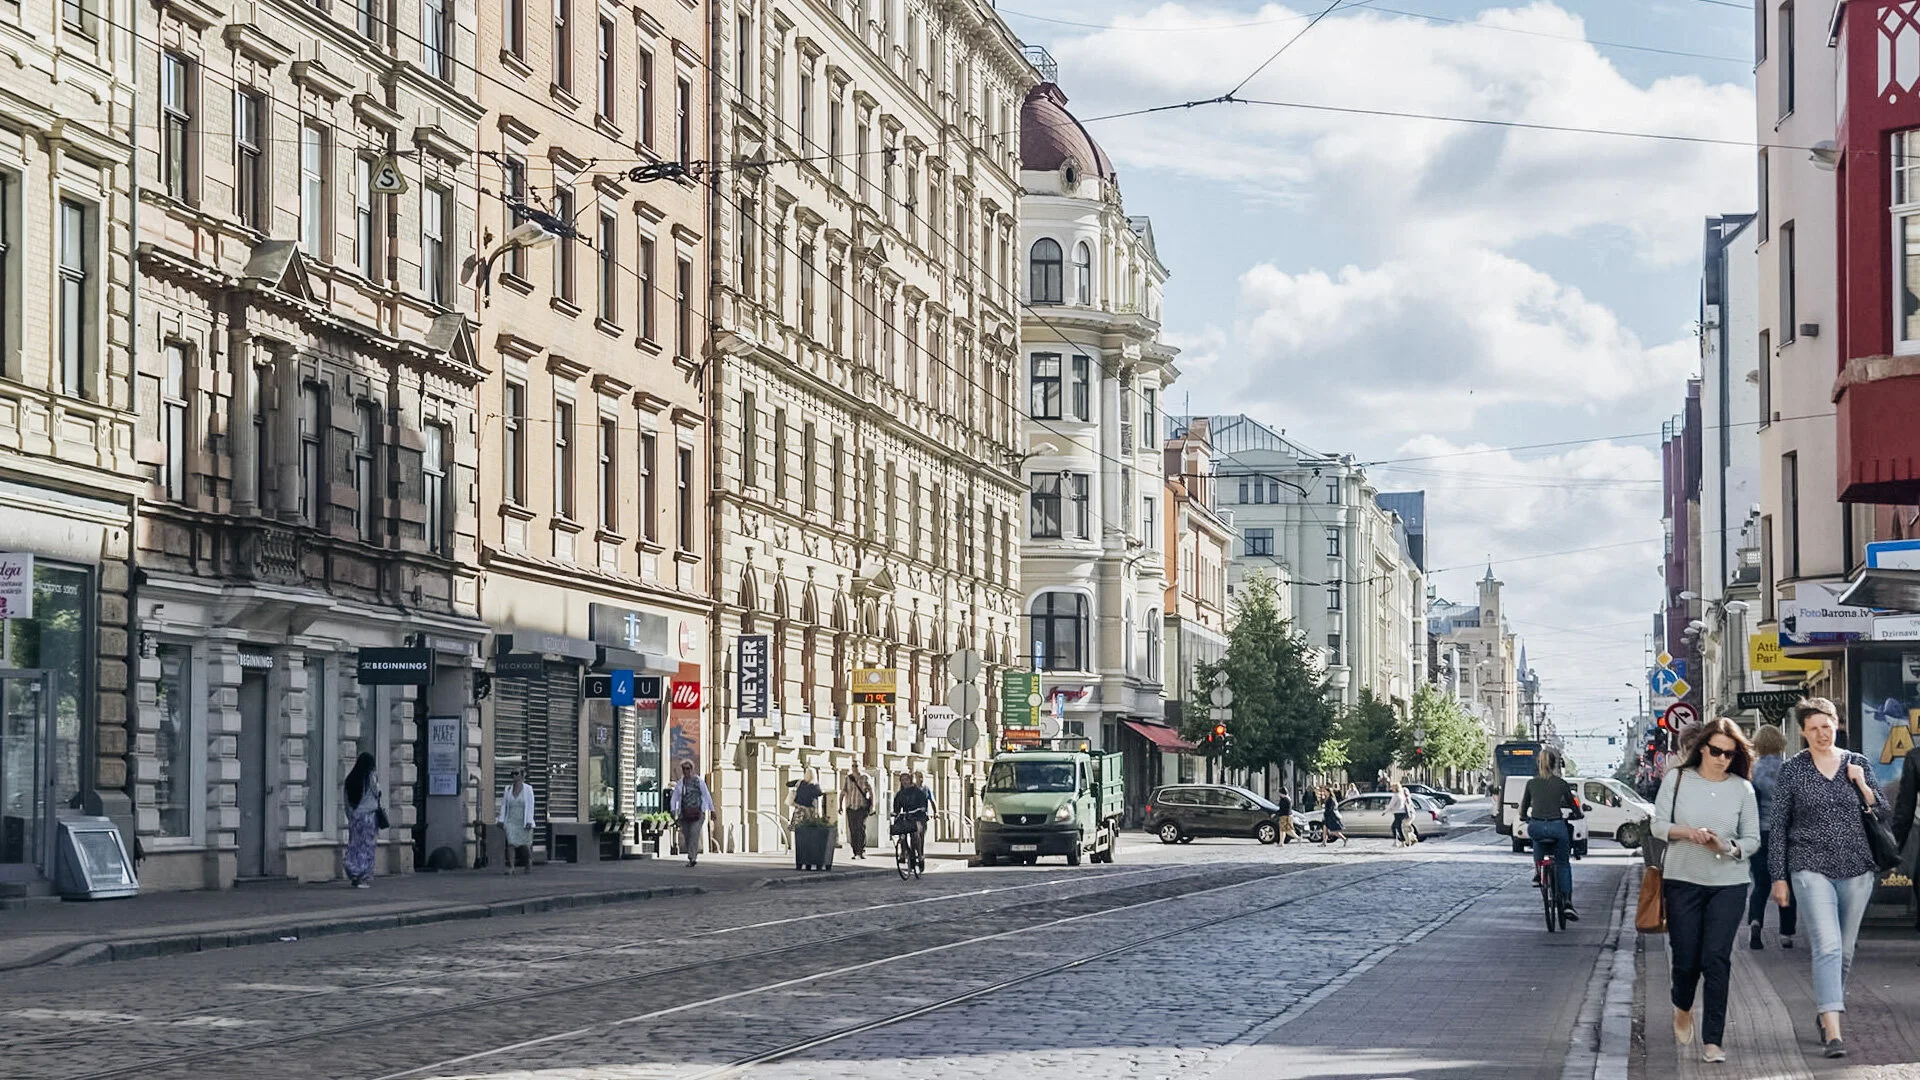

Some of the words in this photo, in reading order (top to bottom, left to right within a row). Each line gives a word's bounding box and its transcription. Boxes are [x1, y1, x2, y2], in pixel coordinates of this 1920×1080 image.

[380, 168, 395, 188] S
[1882, 629, 1918, 638] Dzirnavu
[239, 653, 273, 669] BEGINNINGS
[372, 662, 428, 670] BEGINNINGS
[1756, 653, 1778, 663] Par!
[741, 640, 758, 713] MEYER
[757, 640, 765, 713] MENSWEAR
[593, 681, 602, 694] G
[617, 681, 627, 695] 4
[641, 681, 651, 695] U
[674, 685, 698, 708] illy
